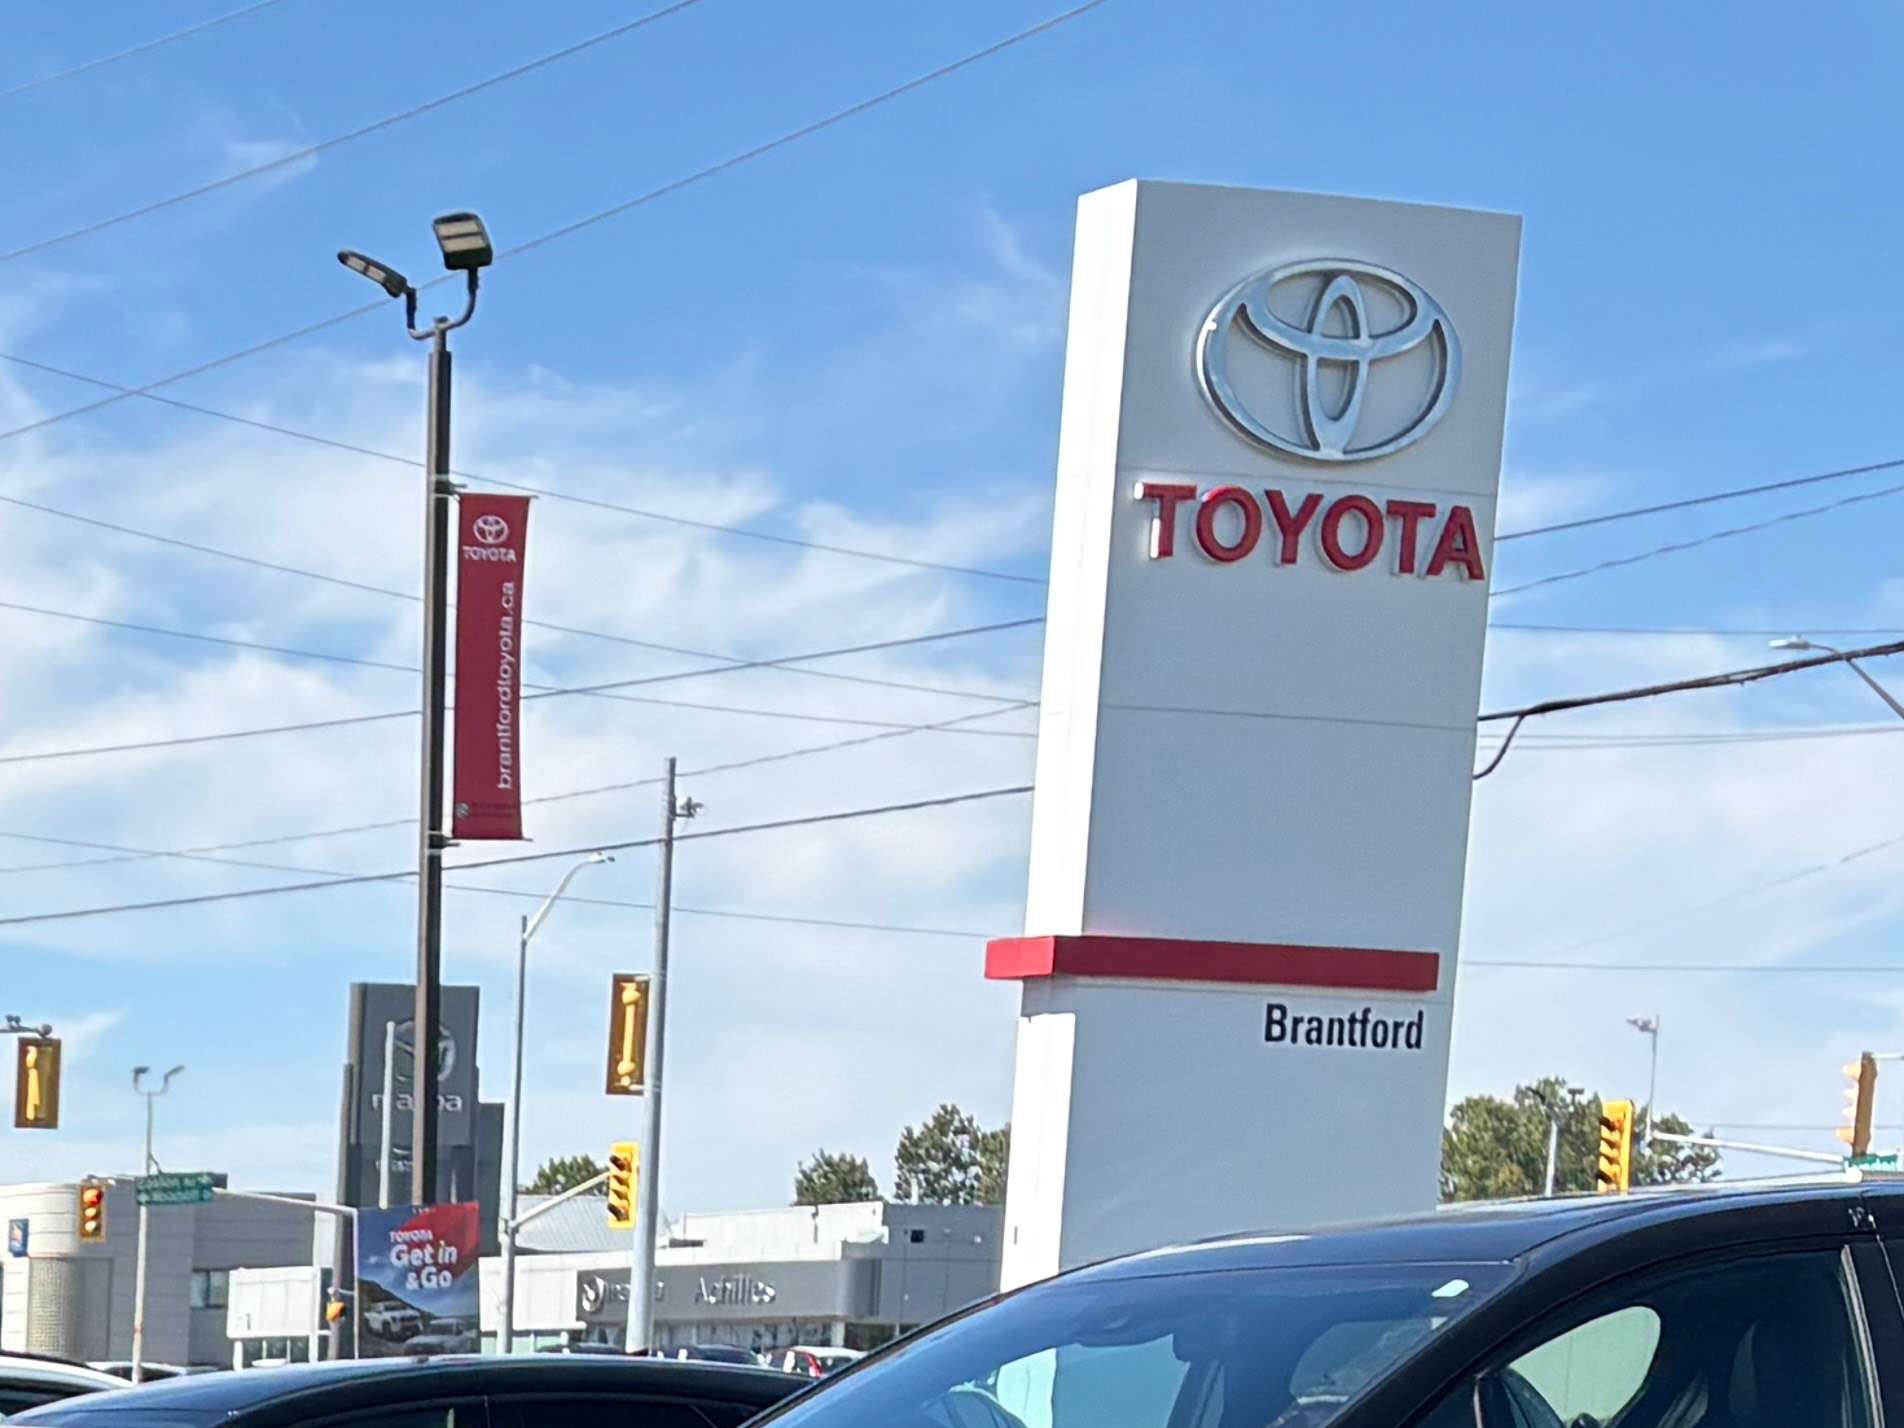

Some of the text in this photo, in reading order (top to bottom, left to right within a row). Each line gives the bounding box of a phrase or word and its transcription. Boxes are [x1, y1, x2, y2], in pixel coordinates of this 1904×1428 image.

[1134, 480, 1486, 581] TOYOTA
[462, 546, 517, 562] TOYOTA
[497, 582, 515, 790] brantfordtoyota.ca
[1263, 1001, 1424, 1051] Brantford
[389, 1229, 433, 1243] TOYOTA
[390, 1240, 458, 1267] Get in
